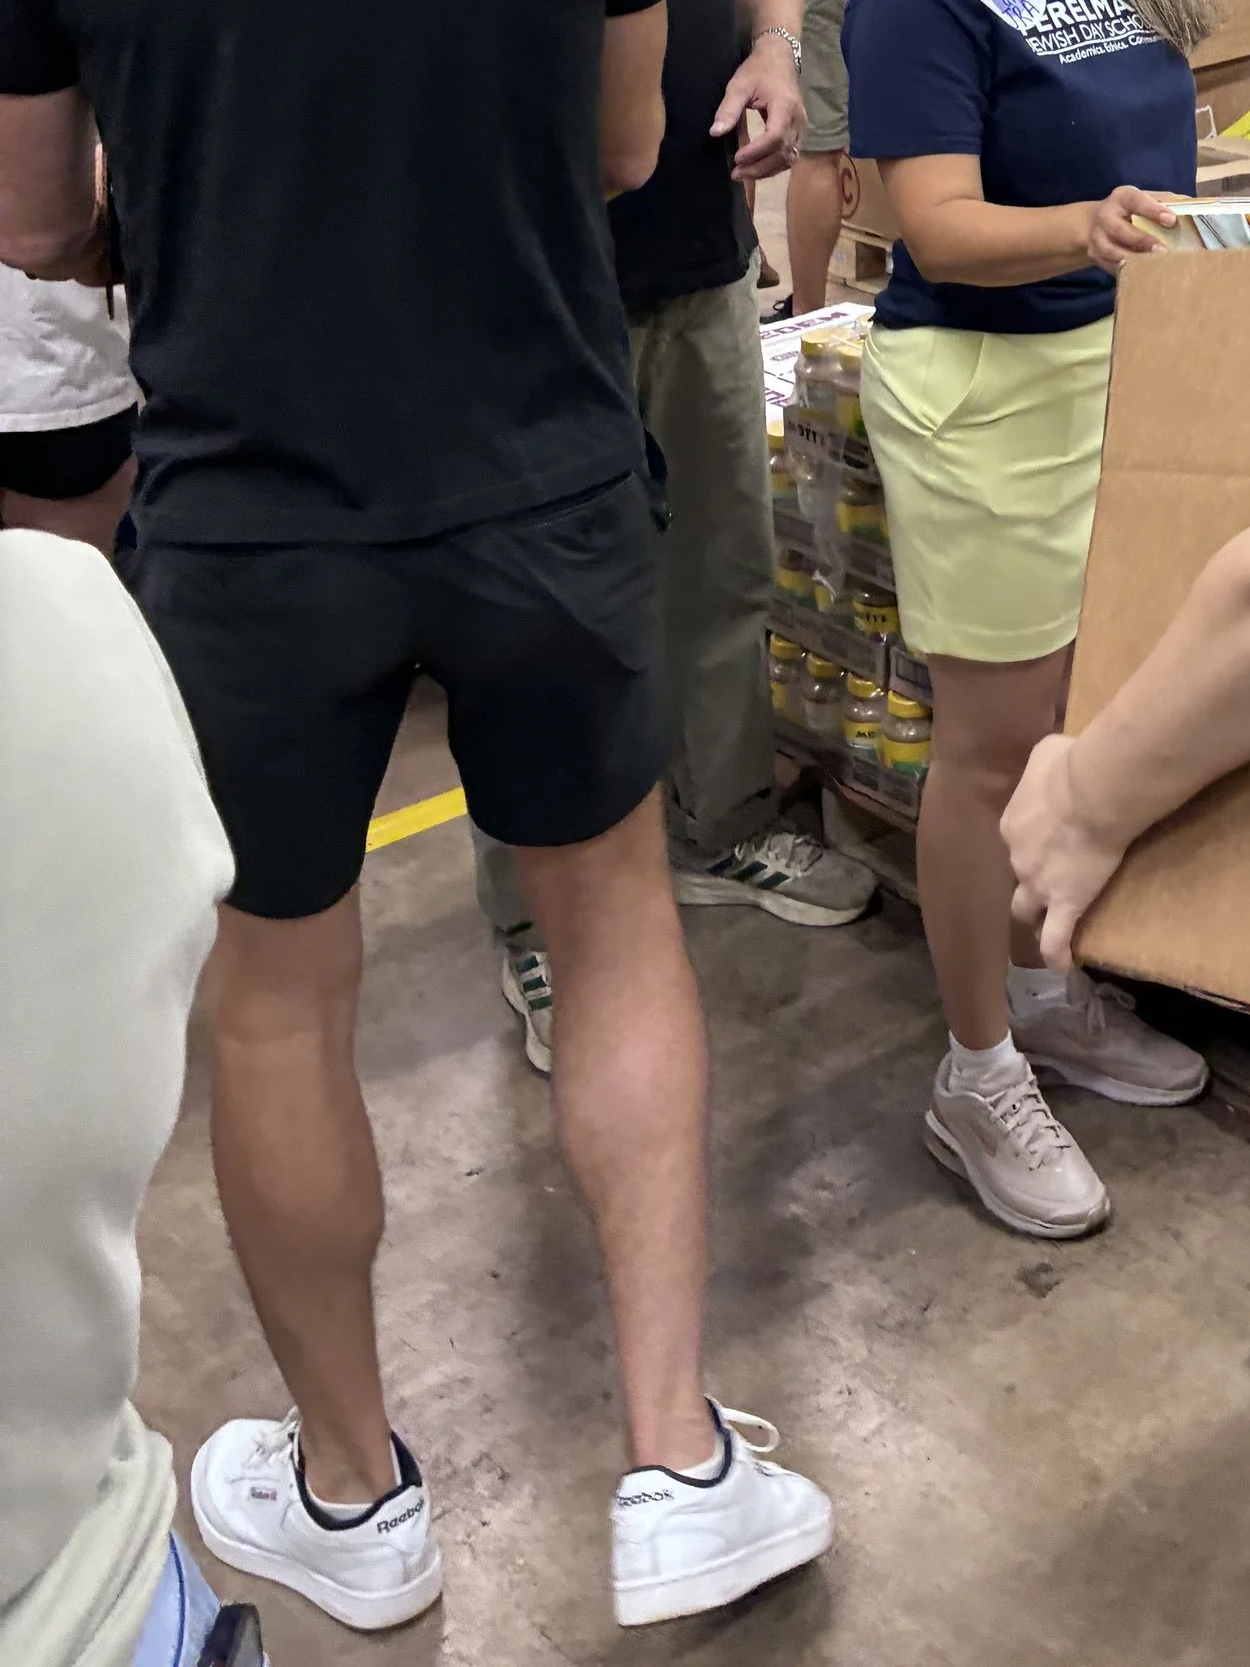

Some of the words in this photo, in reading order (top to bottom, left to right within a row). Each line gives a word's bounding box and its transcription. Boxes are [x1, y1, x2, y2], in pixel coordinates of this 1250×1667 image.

[1025, 26, 1080, 53] JEWISH
[1079, 19, 1107, 42] DAY
[1104, 14, 1144, 37] SCHO
